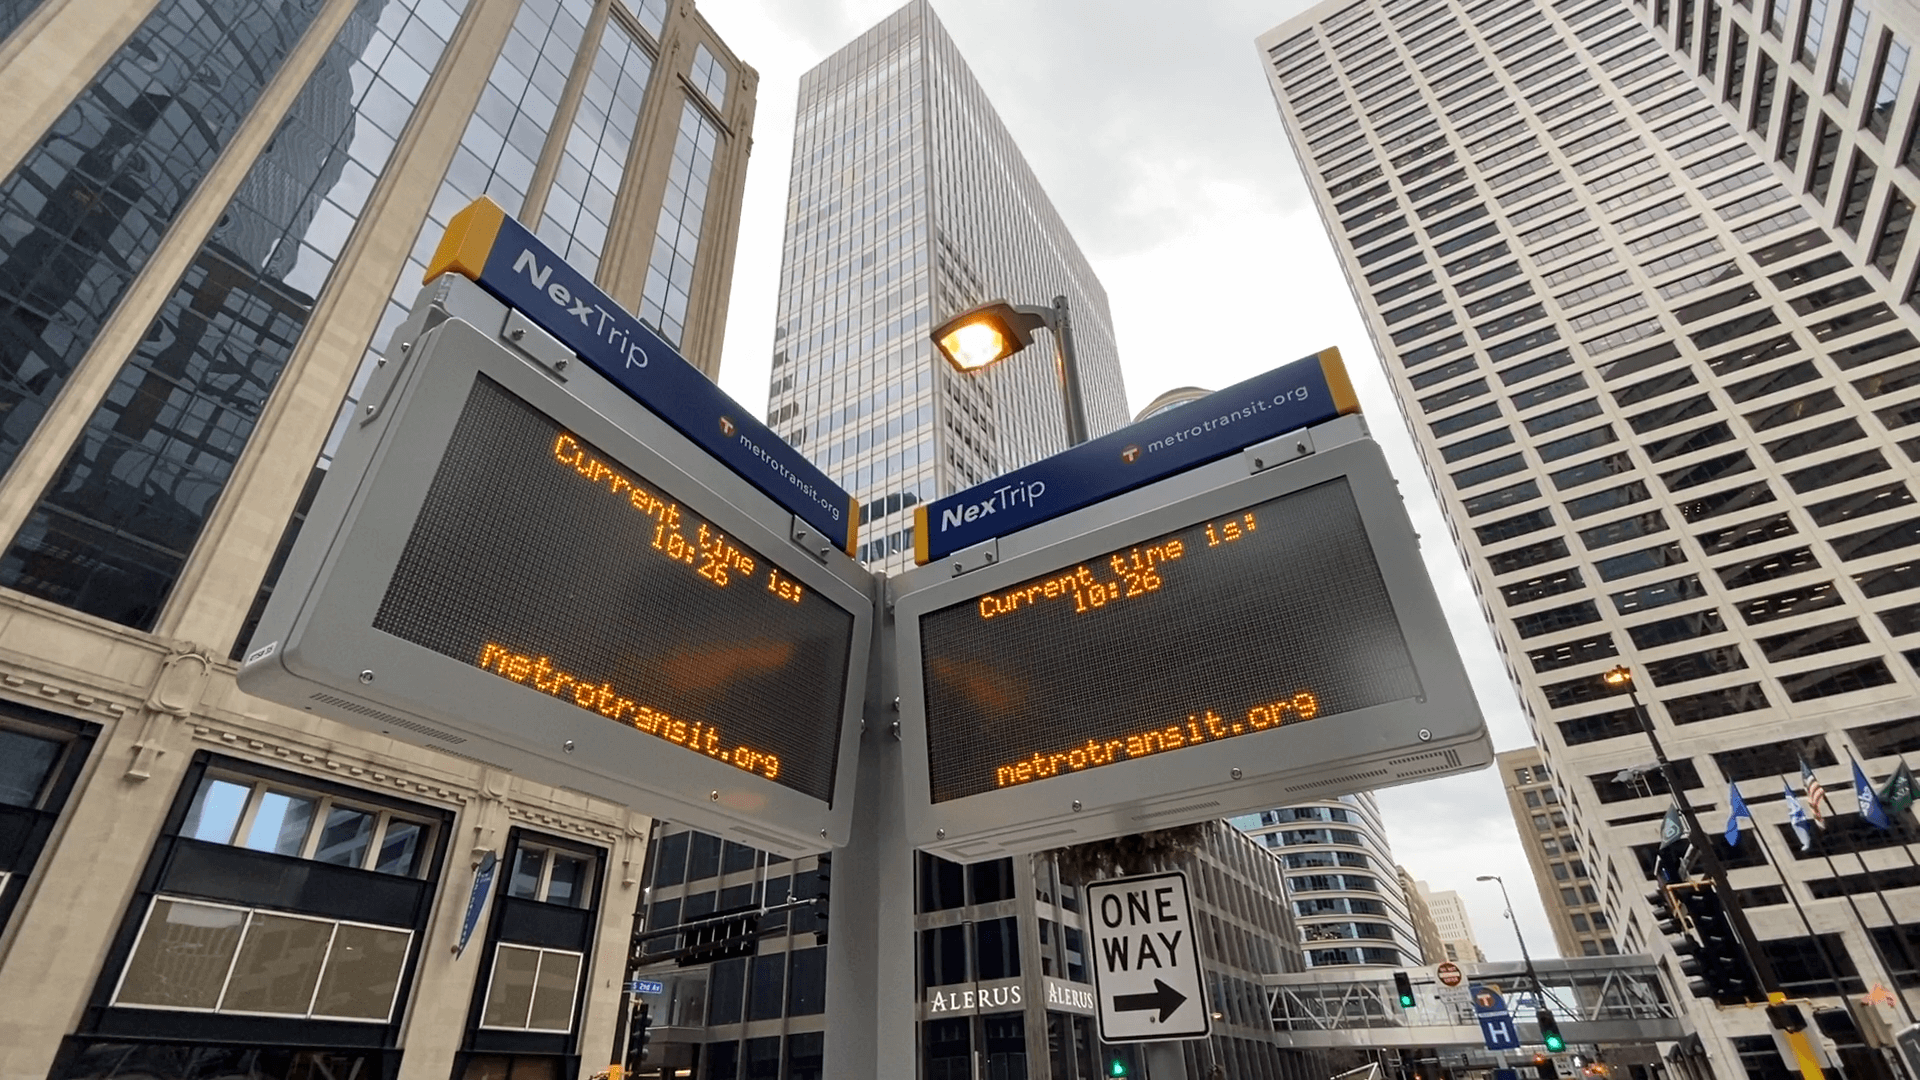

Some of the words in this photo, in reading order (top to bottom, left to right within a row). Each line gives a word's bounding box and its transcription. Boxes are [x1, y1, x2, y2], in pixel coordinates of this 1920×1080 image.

[512, 248, 648, 369] NexTrip
[1148, 385, 1309, 453] metrotransit.org
[740, 435, 840, 521] metrotransit.org
[941, 478, 1046, 532] NexTrip
[555, 435, 680, 529] Current
[699, 524, 754, 575] time
[768, 568, 802, 603] is:
[652, 525, 728, 586] 10:26
[979, 566, 1093, 618] Current
[1110, 540, 1183, 574] time
[1205, 513, 1256, 547] is:
[1073, 567, 1160, 613] 10:26
[481, 643, 780, 778] metrotransit.org
[997, 692, 1318, 786] metrotransit.org
[1101, 887, 1178, 928] ONE
[1102, 930, 1182, 973] WAY
[931, 985, 1022, 1012] ALERUS
[1049, 982, 1094, 1009] ALERUS
[1487, 1021, 1511, 1044] H
